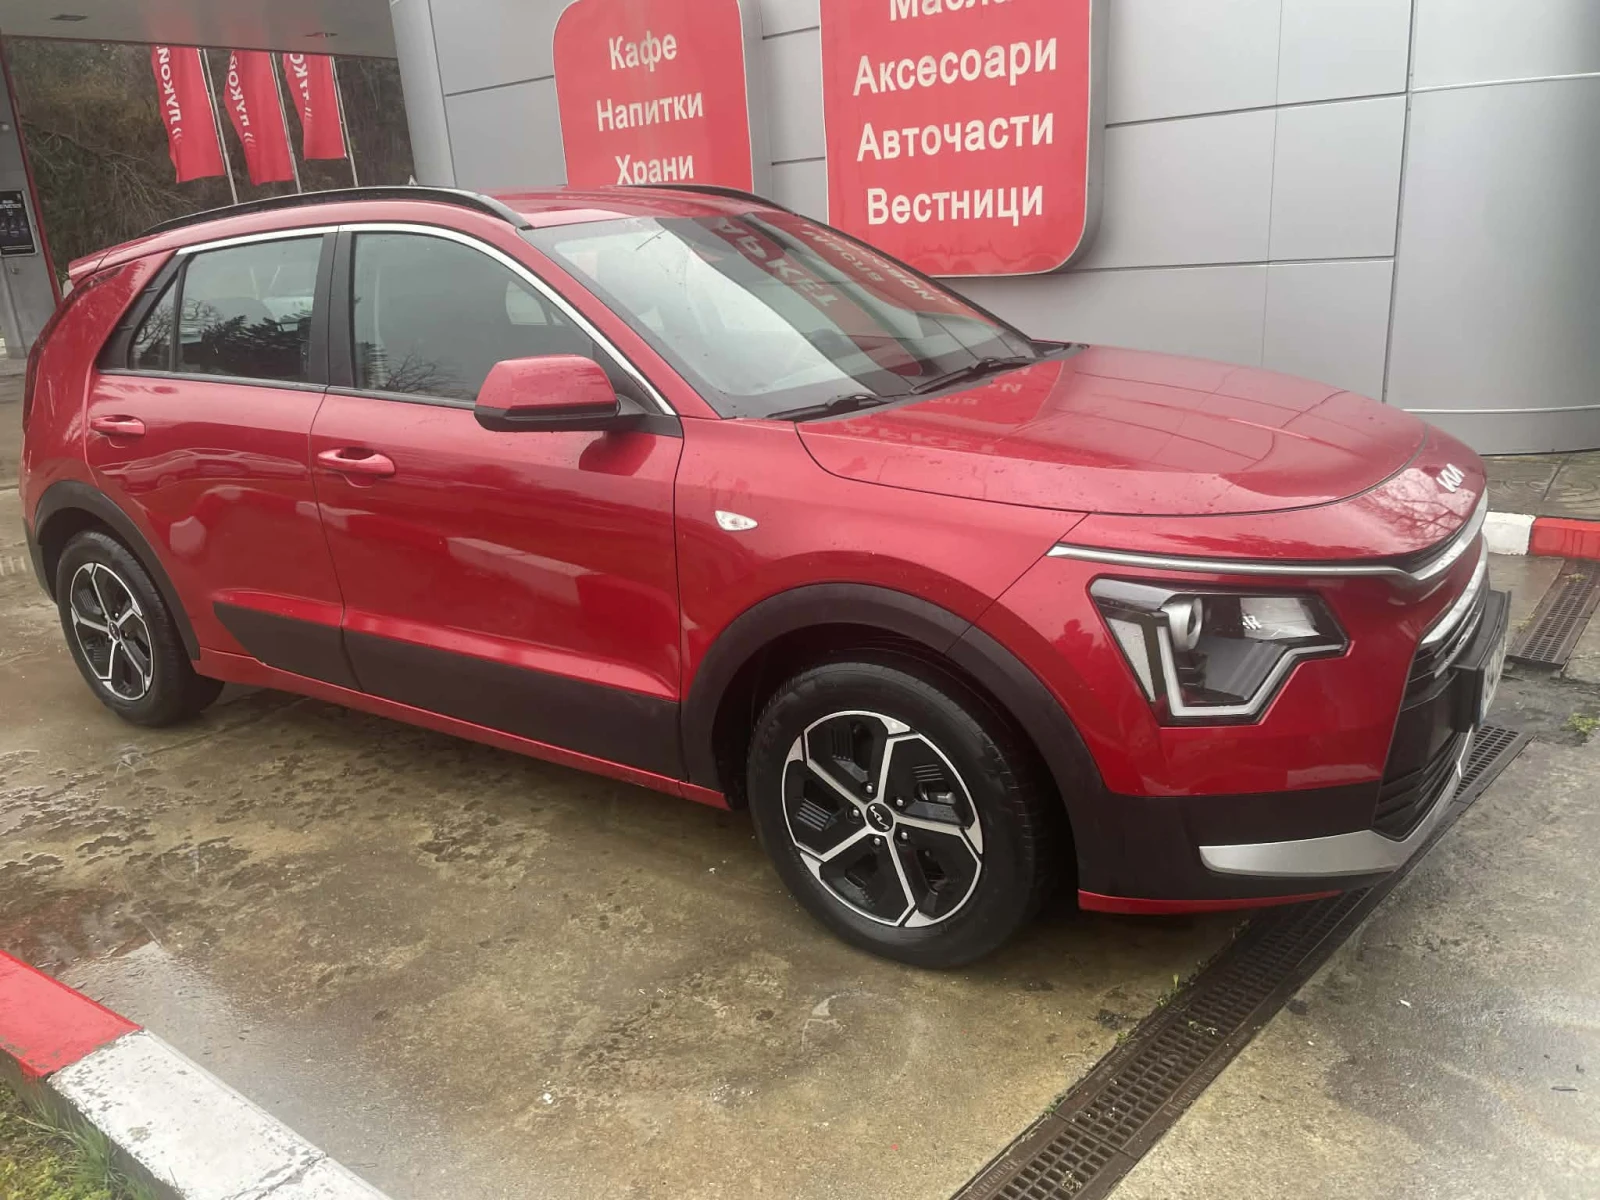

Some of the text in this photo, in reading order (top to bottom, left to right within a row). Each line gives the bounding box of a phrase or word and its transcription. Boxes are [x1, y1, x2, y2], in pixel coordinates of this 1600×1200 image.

[608, 30, 677, 72] Кафе
[852, 37, 1057, 96] Аксесоари
[596, 92, 704, 132] Напитки
[856, 112, 1054, 162] Авточасти
[614, 154, 695, 186] Храни
[867, 185, 1043, 227] Вестници
